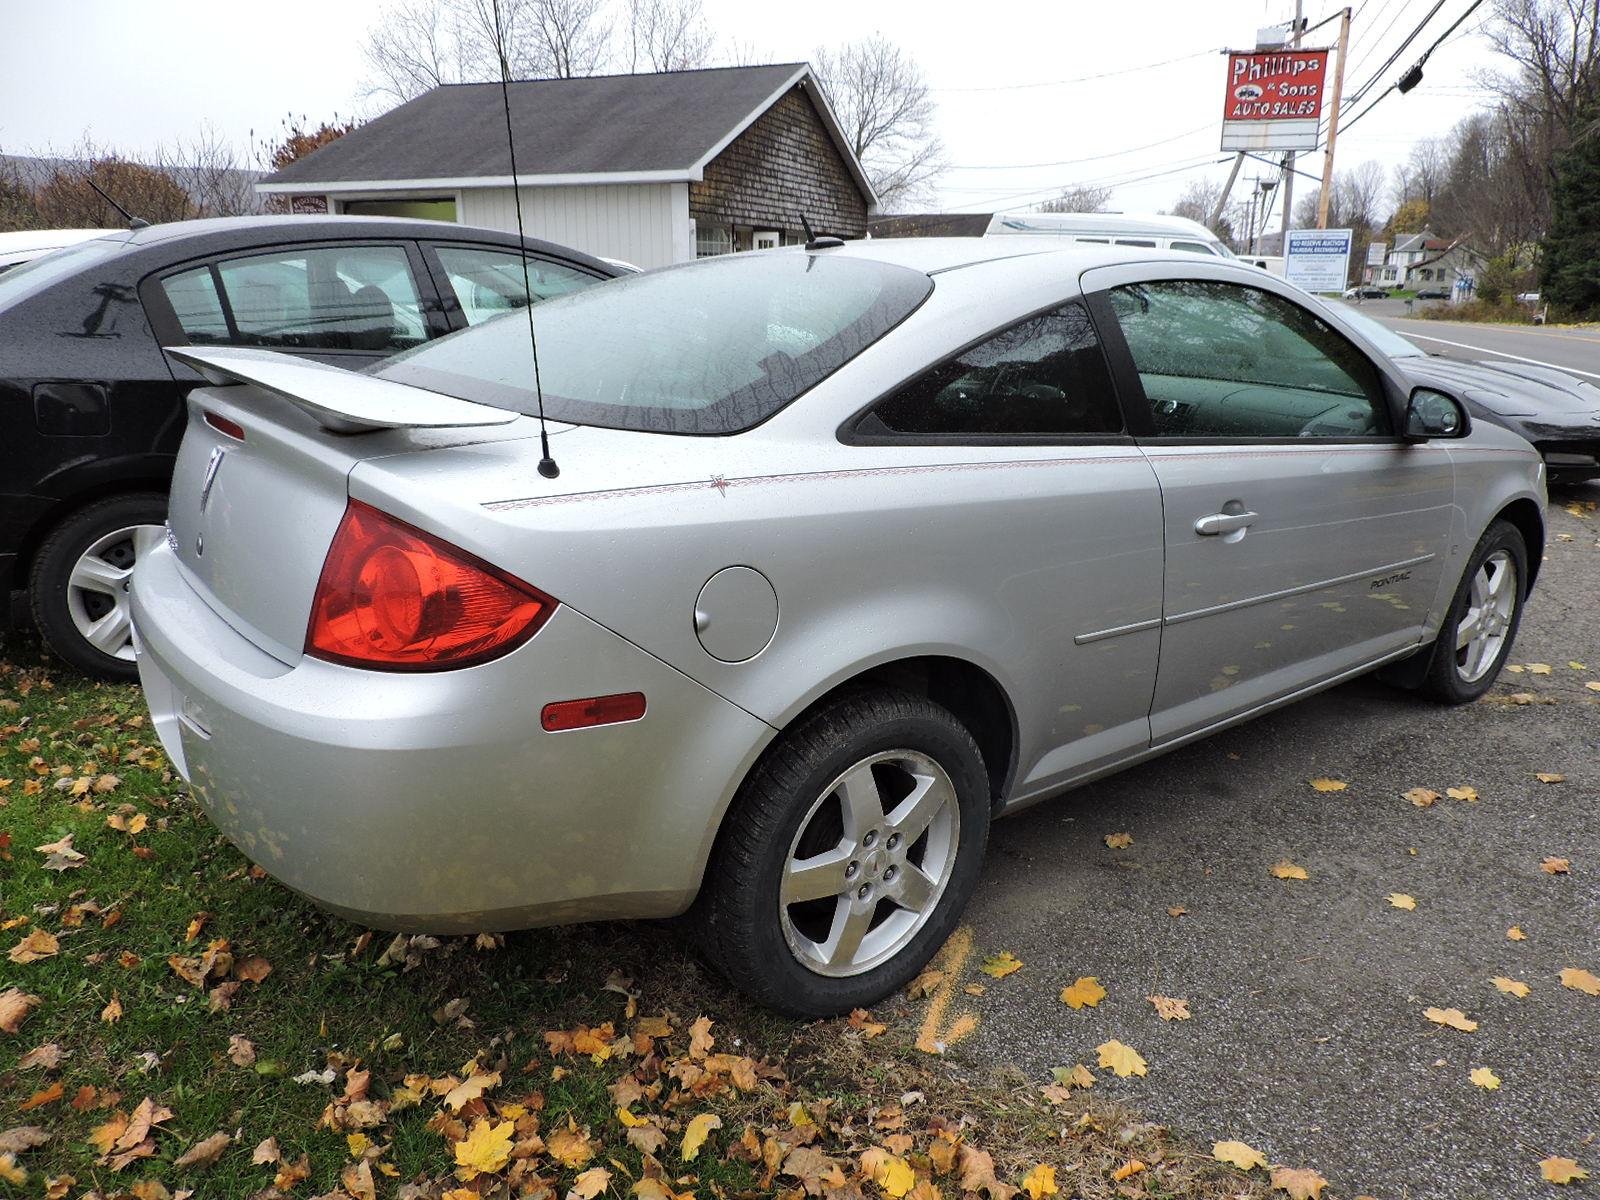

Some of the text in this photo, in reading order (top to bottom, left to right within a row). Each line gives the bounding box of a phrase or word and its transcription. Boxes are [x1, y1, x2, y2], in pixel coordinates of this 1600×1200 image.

[1233, 56, 1320, 86] Phillips
[1279, 81, 1318, 97] Sons
[1232, 100, 1316, 116] AUTO SALES
[1370, 571, 1411, 590] PONTIAC
